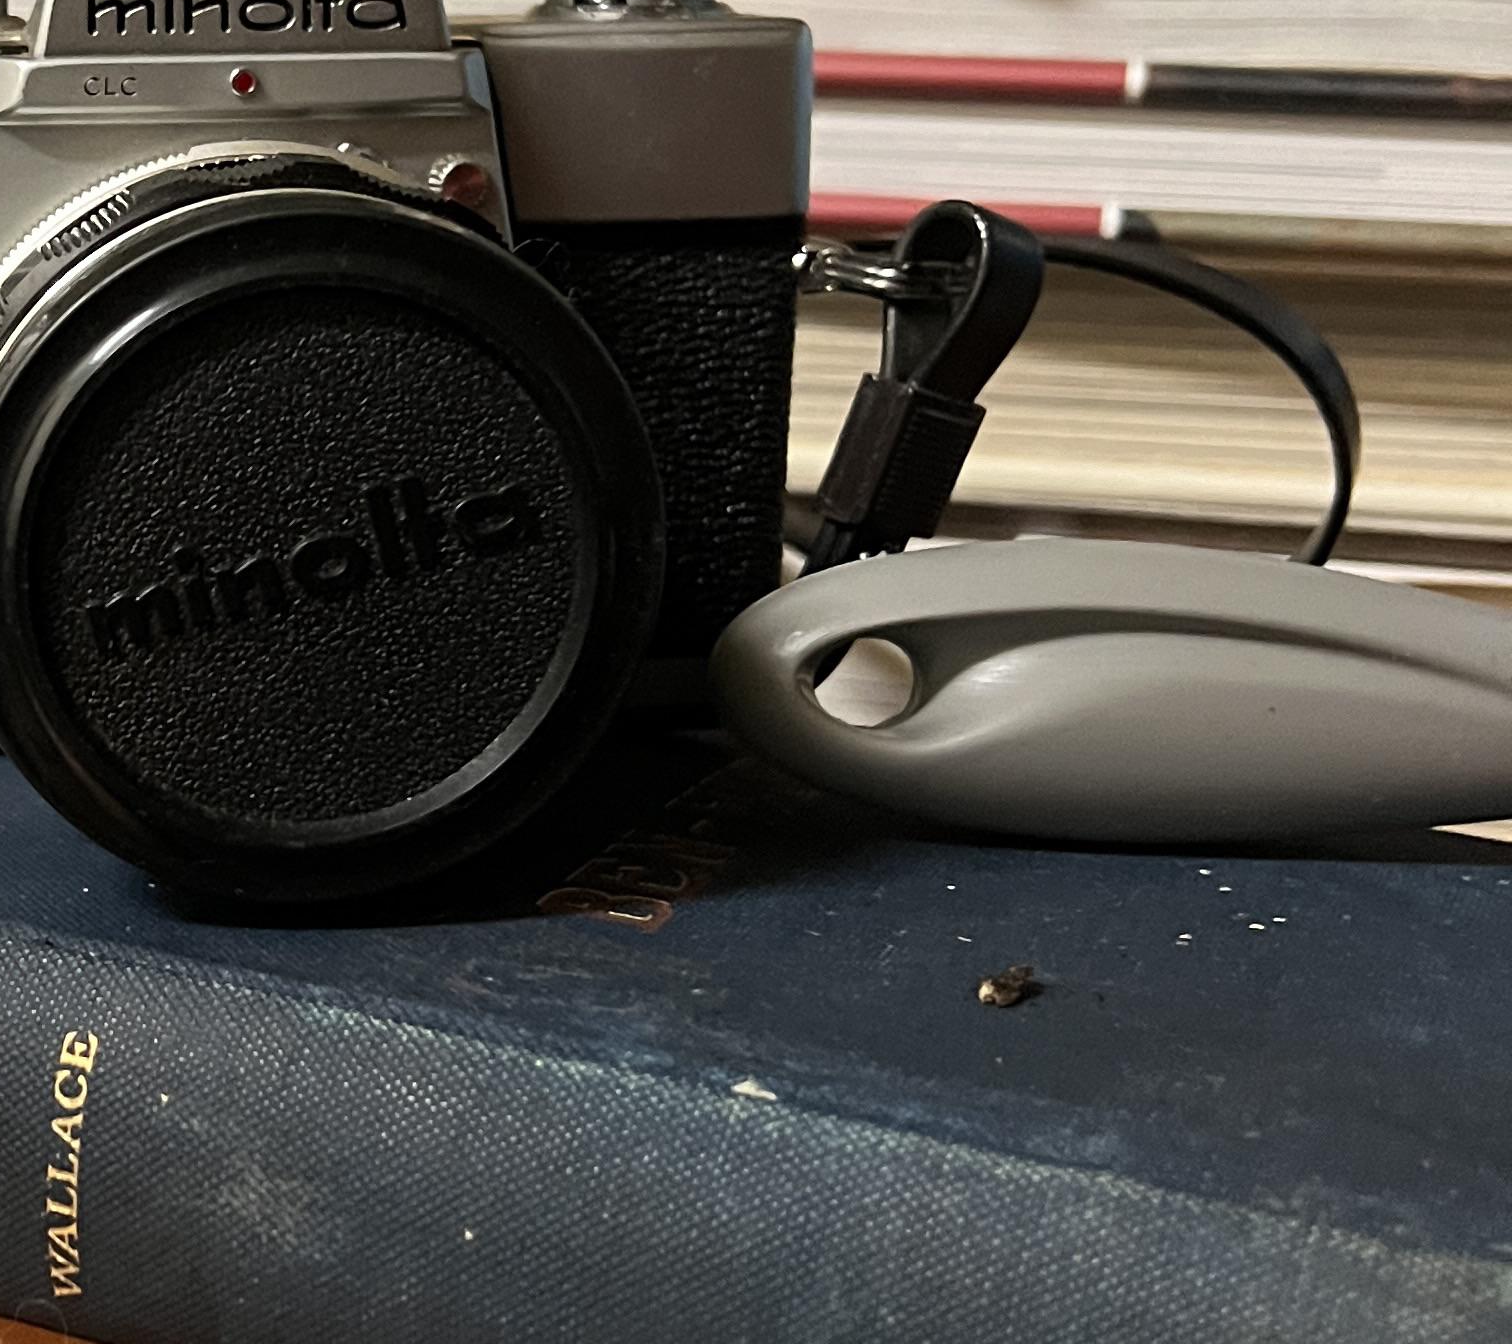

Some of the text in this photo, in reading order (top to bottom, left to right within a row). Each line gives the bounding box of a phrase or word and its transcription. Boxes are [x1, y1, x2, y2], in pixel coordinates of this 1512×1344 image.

[83, 76, 138, 97] CLC
[84, 476, 545, 658] minolta
[45, 1030, 99, 1298] WALLACE
